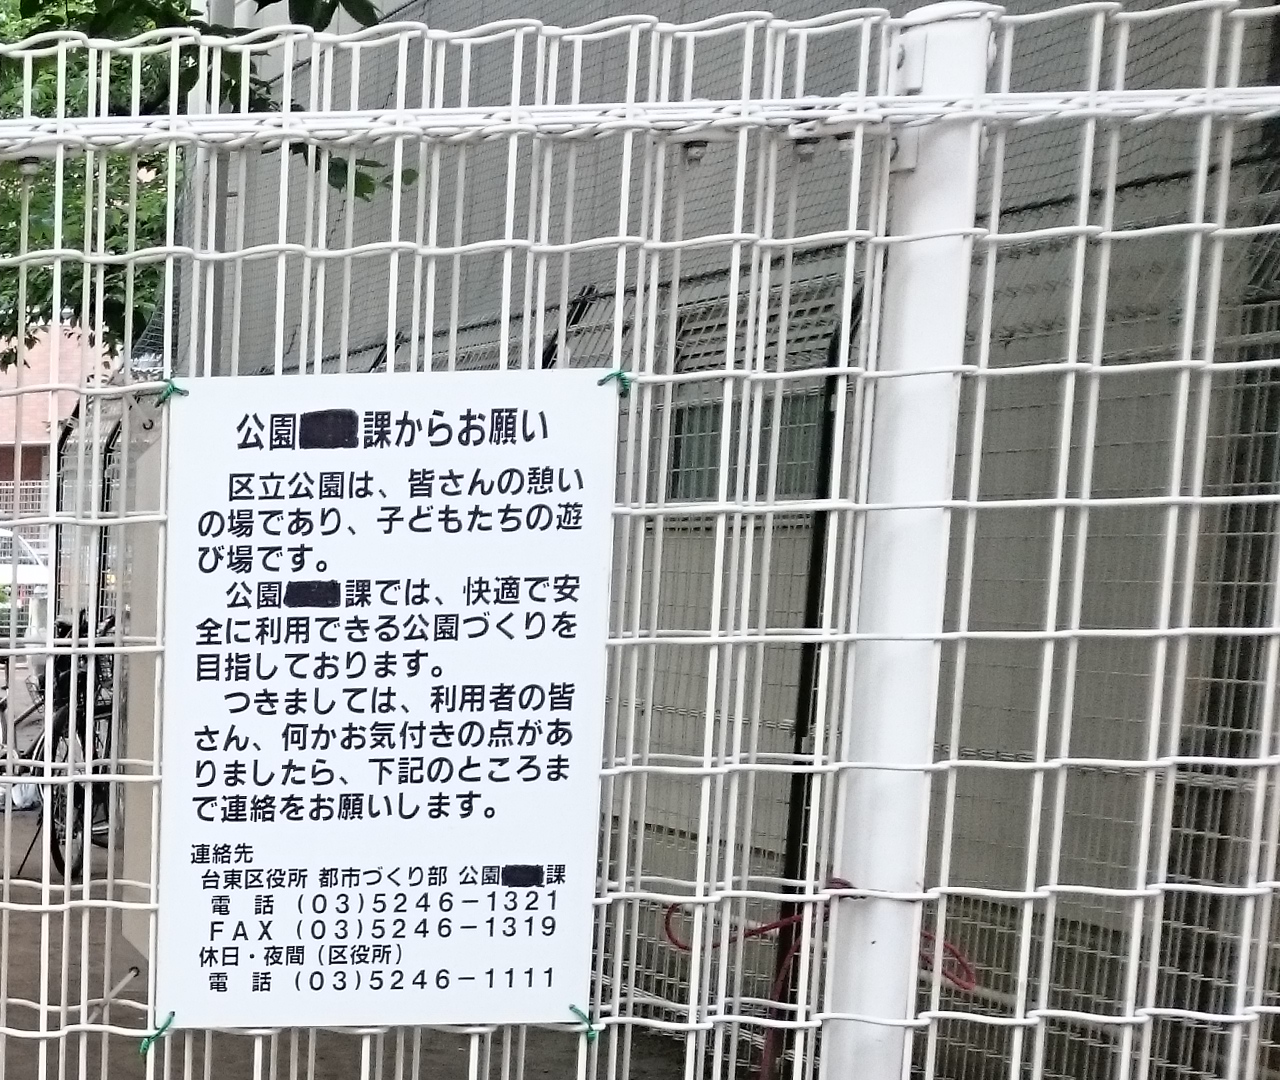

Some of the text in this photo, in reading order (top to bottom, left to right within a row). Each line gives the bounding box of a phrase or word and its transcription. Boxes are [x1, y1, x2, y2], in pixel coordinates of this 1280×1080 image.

[236, 408, 548, 450] 公園課からお願い
[228, 466, 584, 501] 区立公園は、皆さんの憩い
[197, 502, 583, 538] の場であり、子どもたちの遊
[198, 544, 328, 574] び場です。
[225, 574, 580, 609] 公園課では、快適で安
[195, 611, 578, 645] 全に利用できる公園づくりを
[196, 650, 443, 681] 目指しております。
[223, 682, 576, 715] つきましては、利用者の皆
[194, 718, 573, 751] さん、何かお気付きの点があ
[195, 755, 570, 787] りましたら、下記のところま
[192, 791, 496, 822] で連絡をお願いします。
[190, 843, 254, 864] 連絡先
[201, 865, 566, 889] 台東区役所 都市づくり部 公園課
[297, 890, 557, 914] (03)5246-1321
[210, 916, 556, 941] FAX (03)5246-1319
[294, 968, 553, 991] (03)5246-1111
